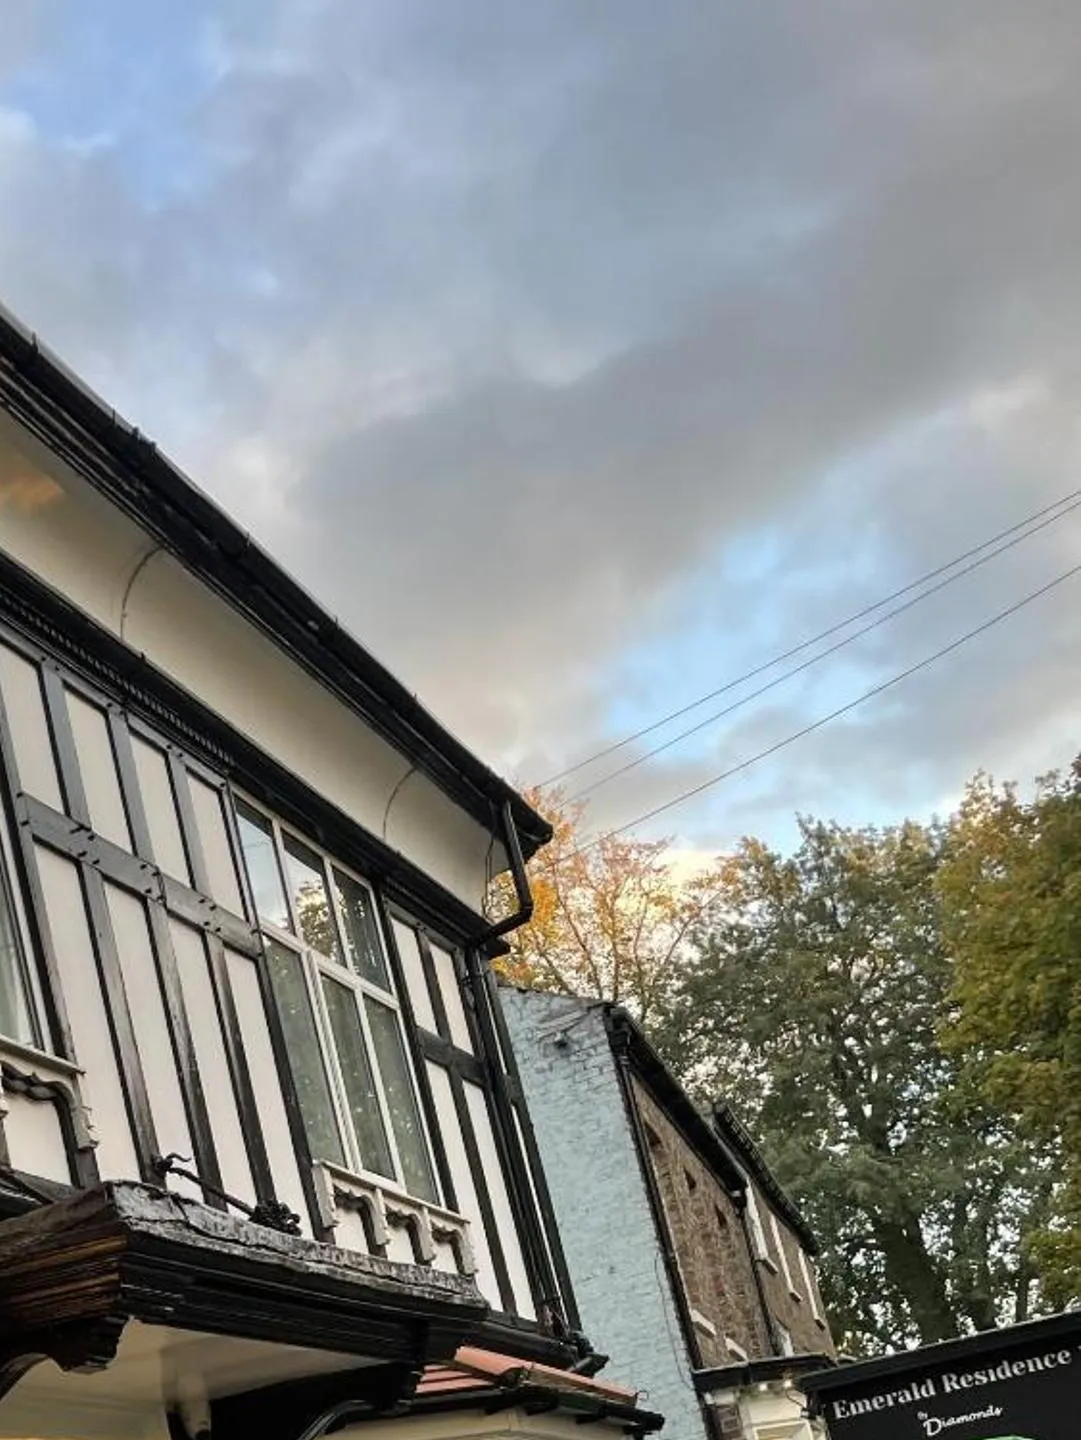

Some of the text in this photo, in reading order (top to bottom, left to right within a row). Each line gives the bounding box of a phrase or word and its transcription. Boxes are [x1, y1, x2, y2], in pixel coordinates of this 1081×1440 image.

[831, 1349, 1072, 1420] Emerald Residence
[923, 1405, 1003, 1436] Diamonds
